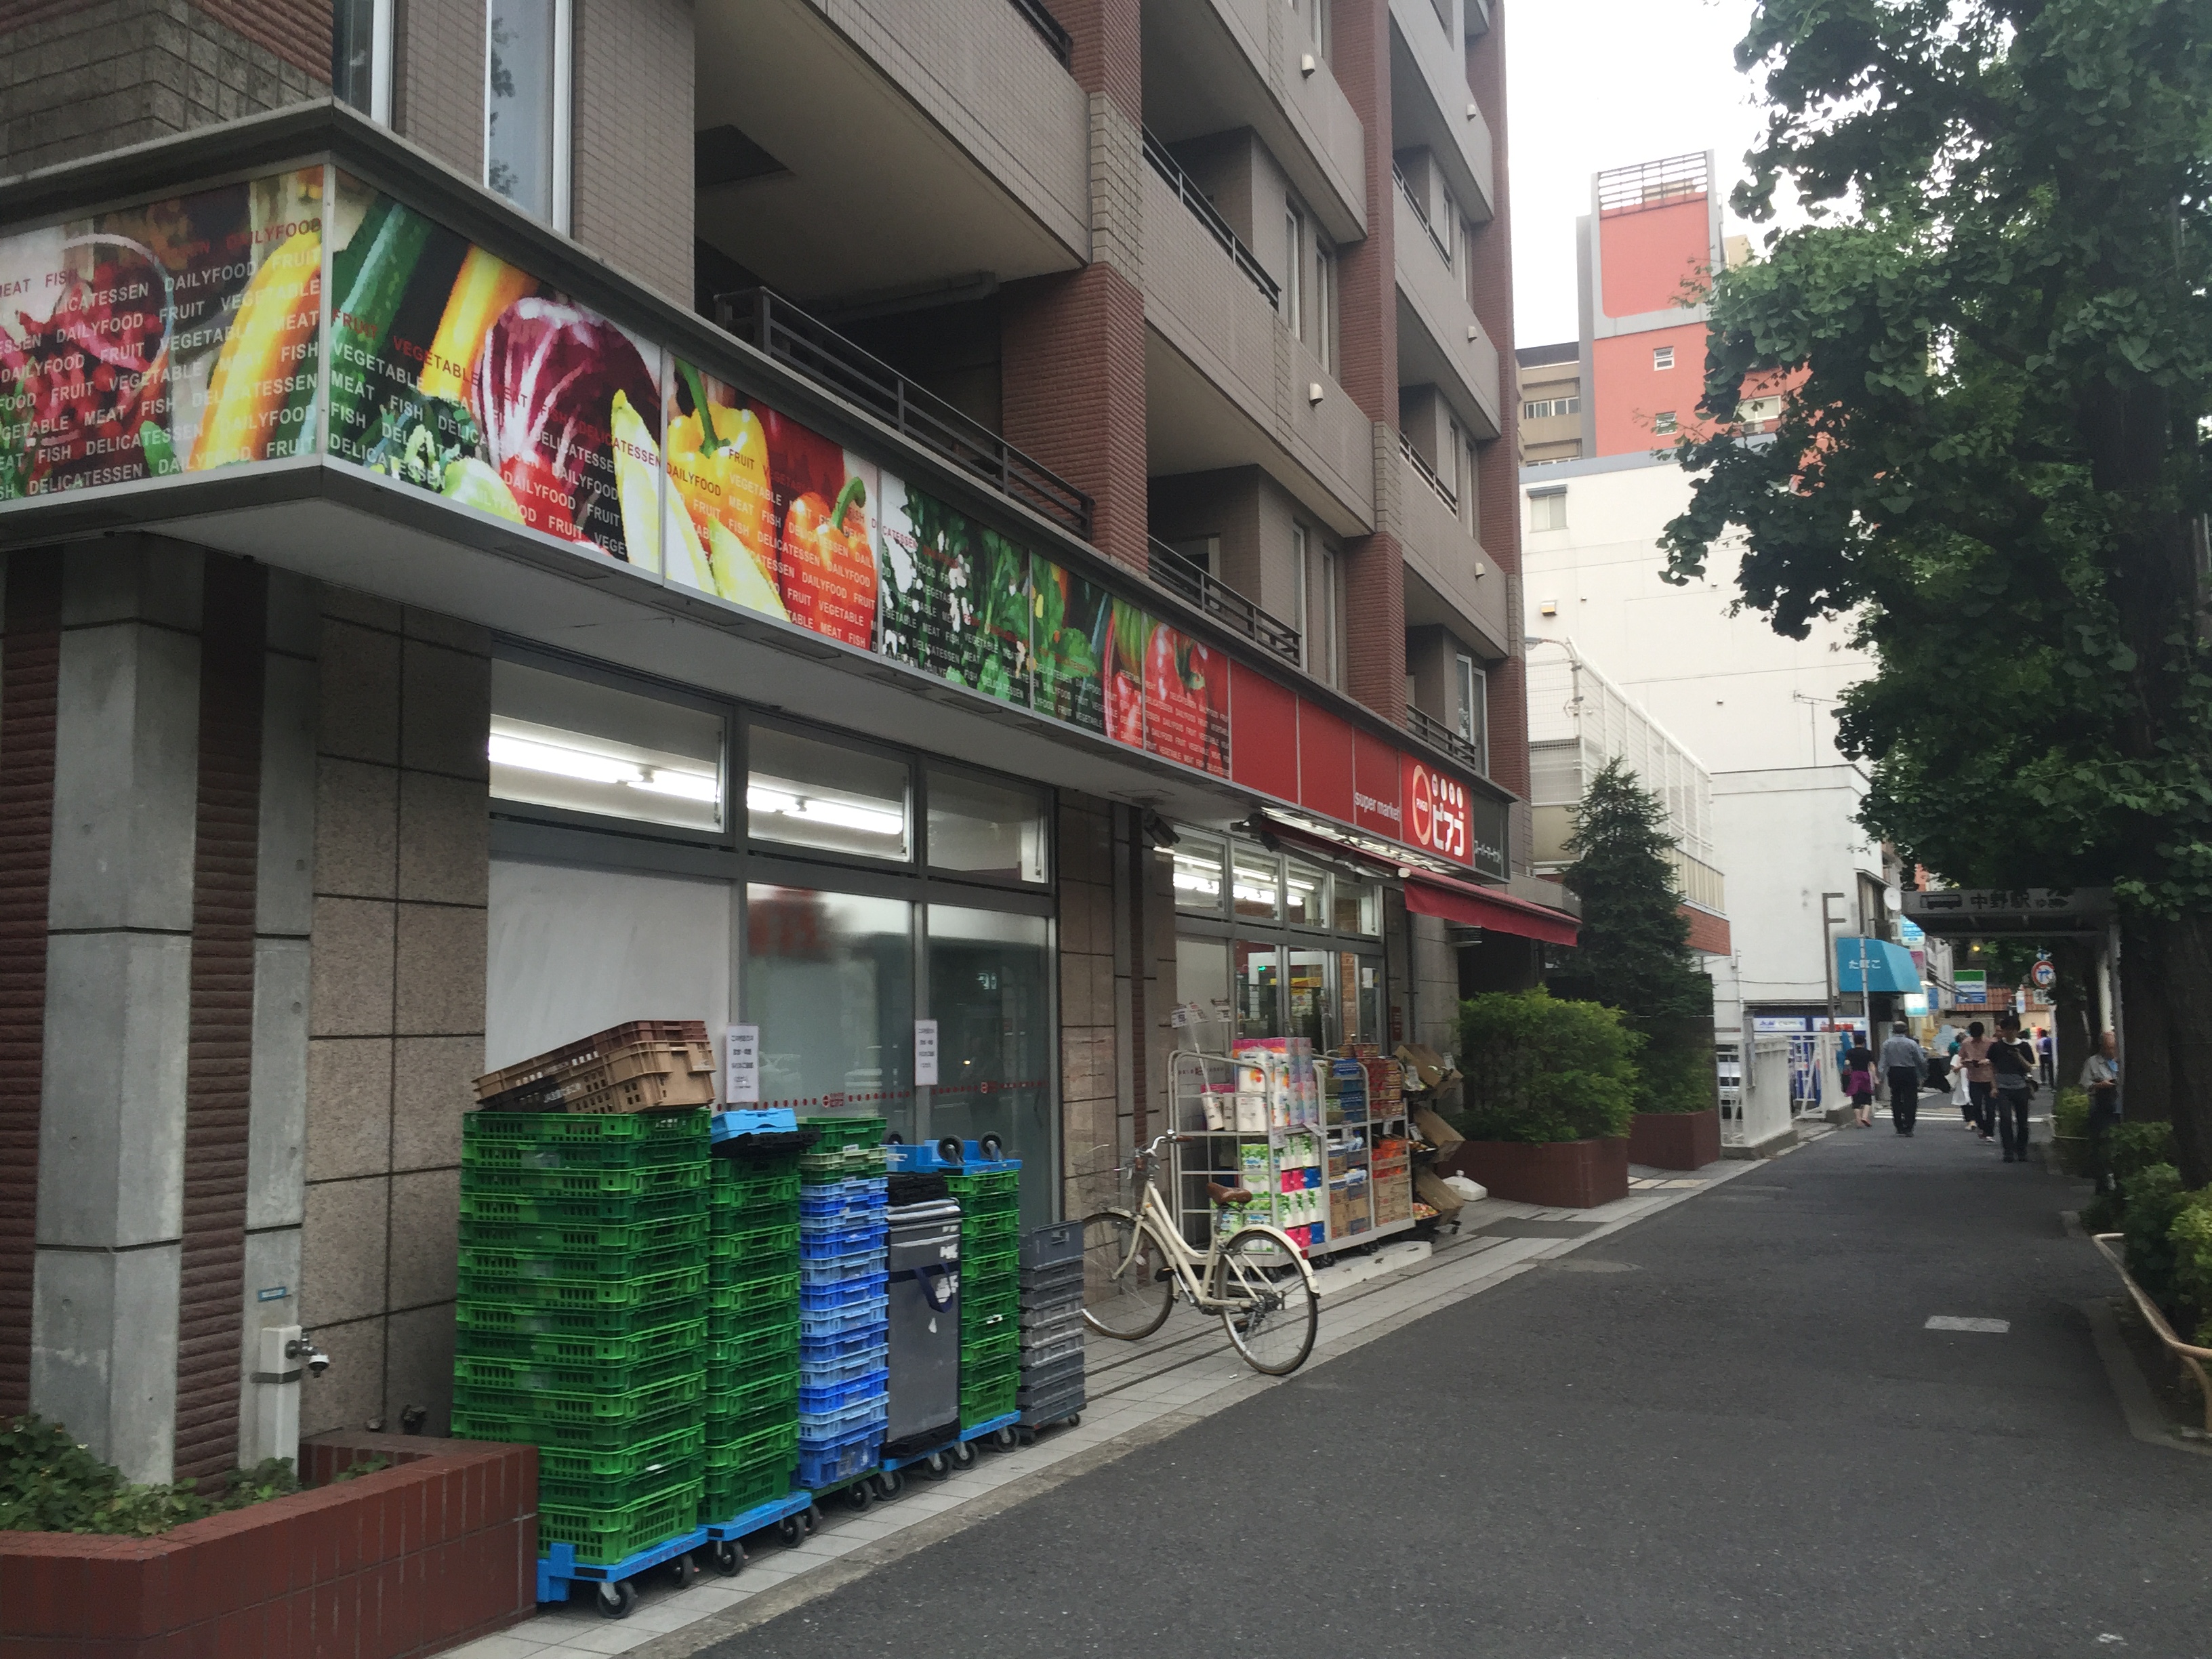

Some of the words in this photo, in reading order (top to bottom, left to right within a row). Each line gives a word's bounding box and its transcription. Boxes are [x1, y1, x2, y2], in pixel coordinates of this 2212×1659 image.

[0, 279, 30, 298] EAT
[165, 261, 257, 292] DAILYFOOD
[56, 313, 144, 344] DAILYFOOD
[159, 301, 205, 323] FRUIT
[1, 353, 85, 384] DAILYFOOD
[100, 342, 145, 363] FRUIT
[52, 381, 94, 405] FRUIT
[109, 361, 203, 392] VEGETABLE
[281, 342, 319, 363] FISH
[84, 405, 126, 427] MEAT
[141, 397, 176, 417] FISH
[333, 342, 424, 391] VEGETABLE
[693, 498, 721, 520] FRUIT
[393, 335, 479, 386] VEGETABLE
[666, 462, 722, 496] DAILYFOOD
[38, 445, 71, 464] FISH
[86, 424, 203, 456] DELICATESSEN
[331, 369, 375, 401] MEAT
[390, 394, 424, 422] FISH
[552, 466, 619, 501] DAILYFOOD
[29, 463, 143, 495] DELICATESSEN
[266, 436, 315, 458] FRUIT
[330, 401, 366, 428] FISH
[504, 470, 576, 510] DAILYFOOD
[587, 503, 620, 527] FRUIT
[729, 448, 755, 470] FRUIT
[329, 433, 446, 489] DELICATESSEN
[548, 516, 583, 539] FRUIT
[729, 472, 782, 506] VEGETABLE
[729, 495, 754, 516] MEAT
[761, 510, 781, 528] FISH
[729, 518, 750, 537] FISH
[757, 531, 821, 567] DELICATESSEN
[827, 560, 872, 588] DAILYFOOD
[787, 588, 812, 607] FRUIT
[818, 599, 865, 628] VEGETABLE
[802, 571, 847, 599] DAILYFOOD
[853, 592, 876, 611] FRUIT
[820, 621, 842, 640] MEAT
[848, 632, 866, 649] FISH
[1355, 792, 1376, 813] super
[1432, 802, 1465, 857] ピアゴ
